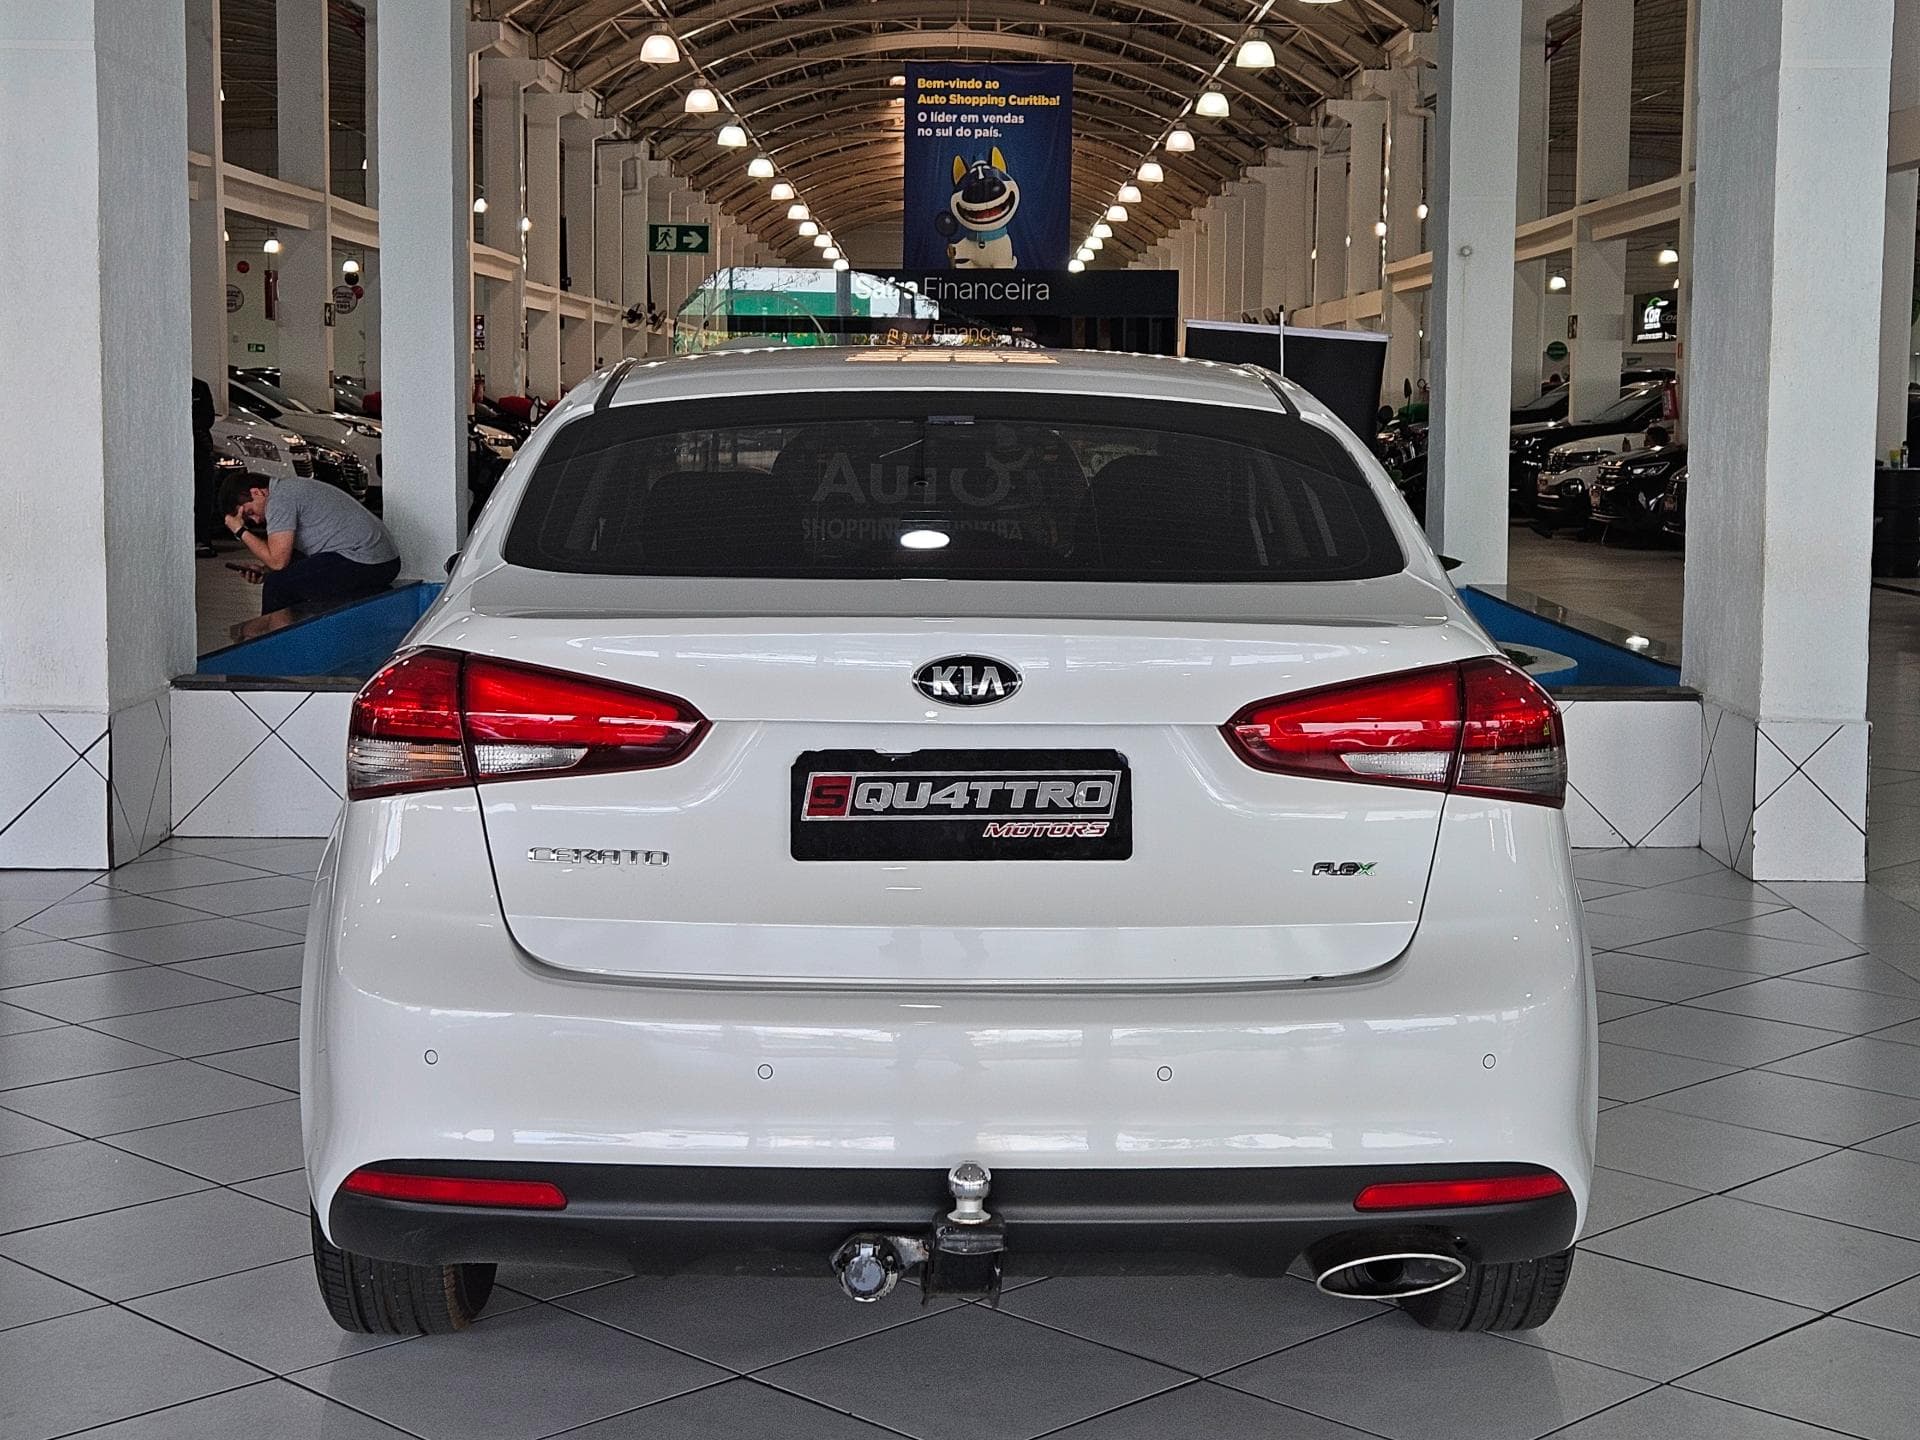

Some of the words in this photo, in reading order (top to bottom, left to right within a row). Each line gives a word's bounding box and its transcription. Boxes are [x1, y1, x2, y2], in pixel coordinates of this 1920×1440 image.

[917, 78, 983, 90] Bem-vindo
[984, 80, 1000, 90] ao
[917, 94, 947, 105] Auto
[949, 94, 1006, 107] Shopping
[1008, 94, 1060, 106] Curitiba!
[917, 112, 927, 123] O
[930, 111, 958, 124] líder
[960, 114, 979, 124] em
[982, 112, 1025, 124] vendas
[917, 128, 933, 137] no
[935, 126, 953, 137] sul
[955, 126, 972, 137] do
[974, 126, 1003, 139] país.
[924, 277, 1050, 301] Financeira
[801, 517, 903, 541] SHOPPIN
[932, 666, 1005, 696] KIA
[983, 821, 1110, 838] MOTORS
[528, 847, 669, 866] CERATO
[1312, 862, 1378, 876] FLEX
